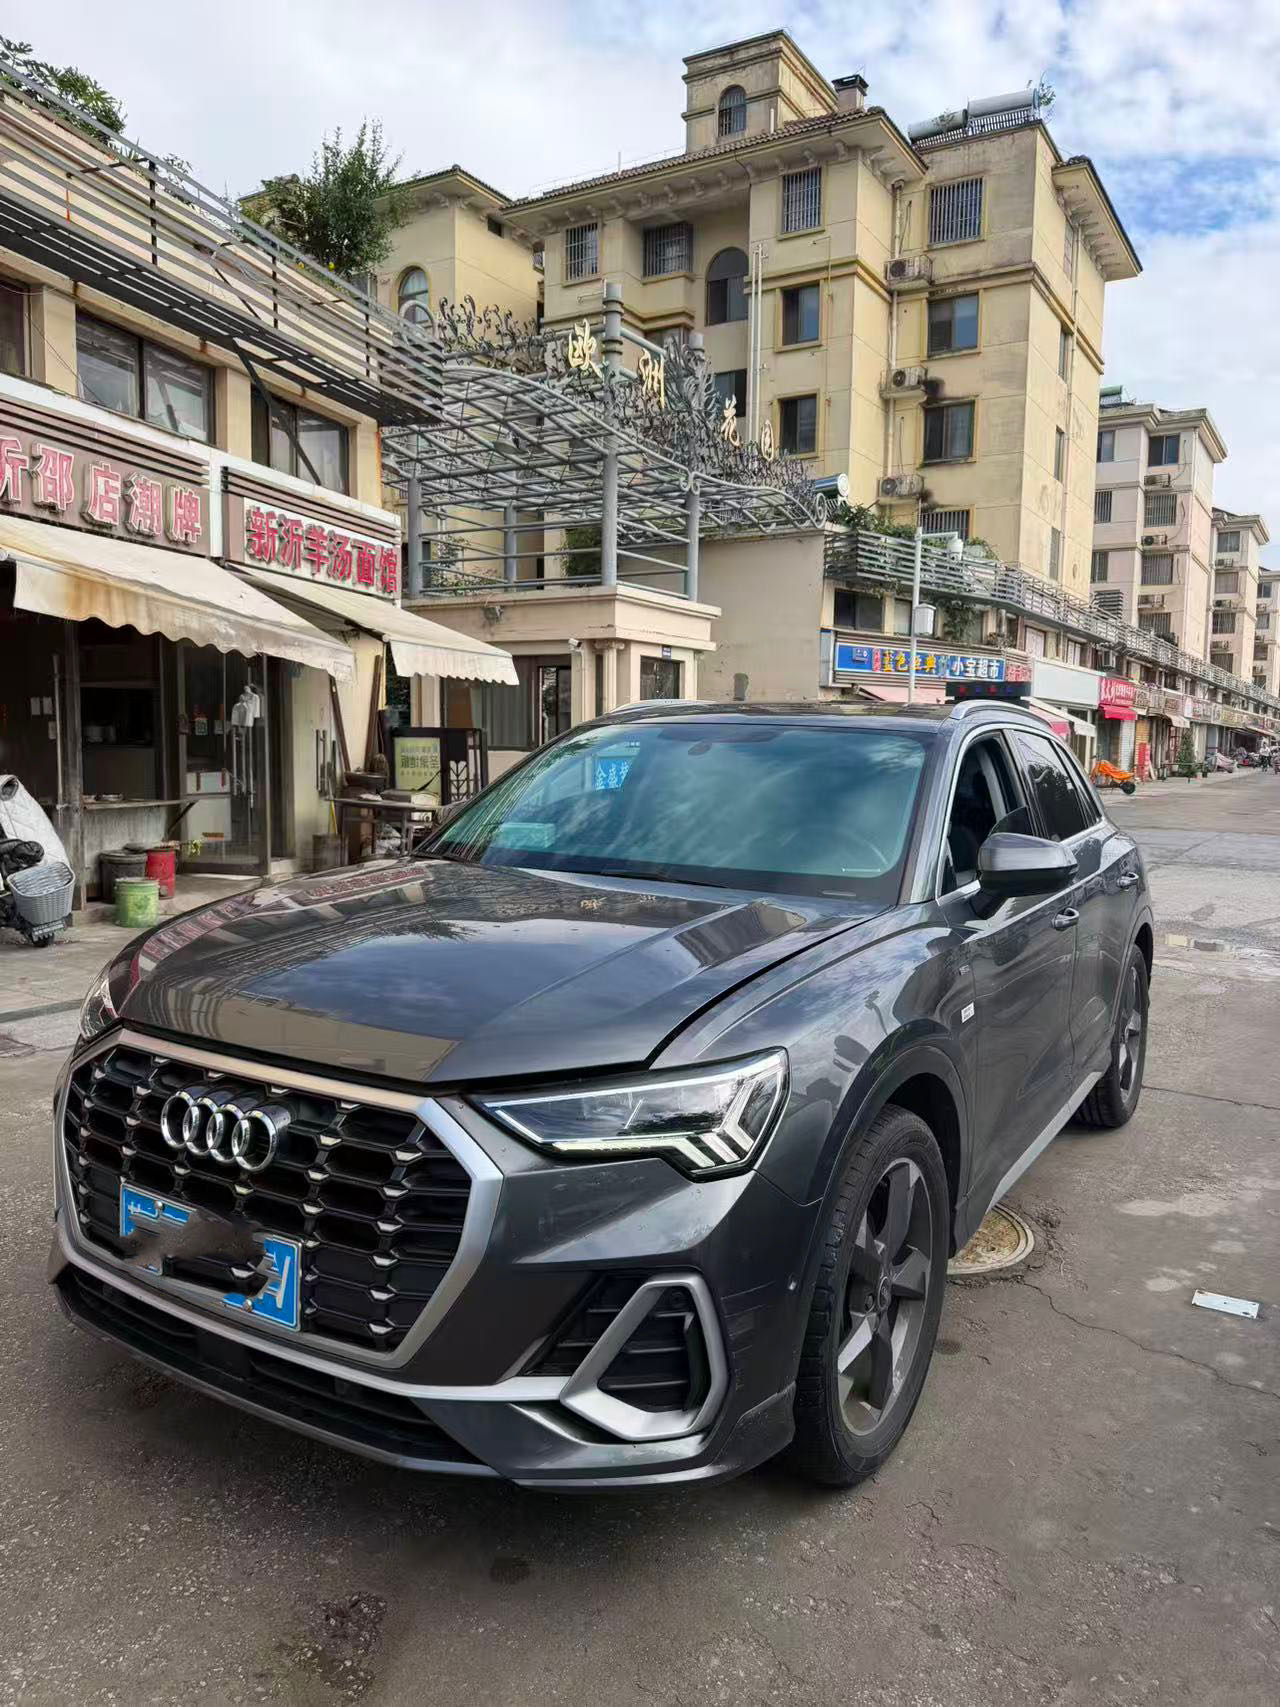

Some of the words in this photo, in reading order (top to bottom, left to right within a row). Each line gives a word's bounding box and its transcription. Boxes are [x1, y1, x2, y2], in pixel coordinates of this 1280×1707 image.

[248, 506, 398, 593] 新沂羊汤面馆
[951, 657, 1001, 679] 小宝超市
